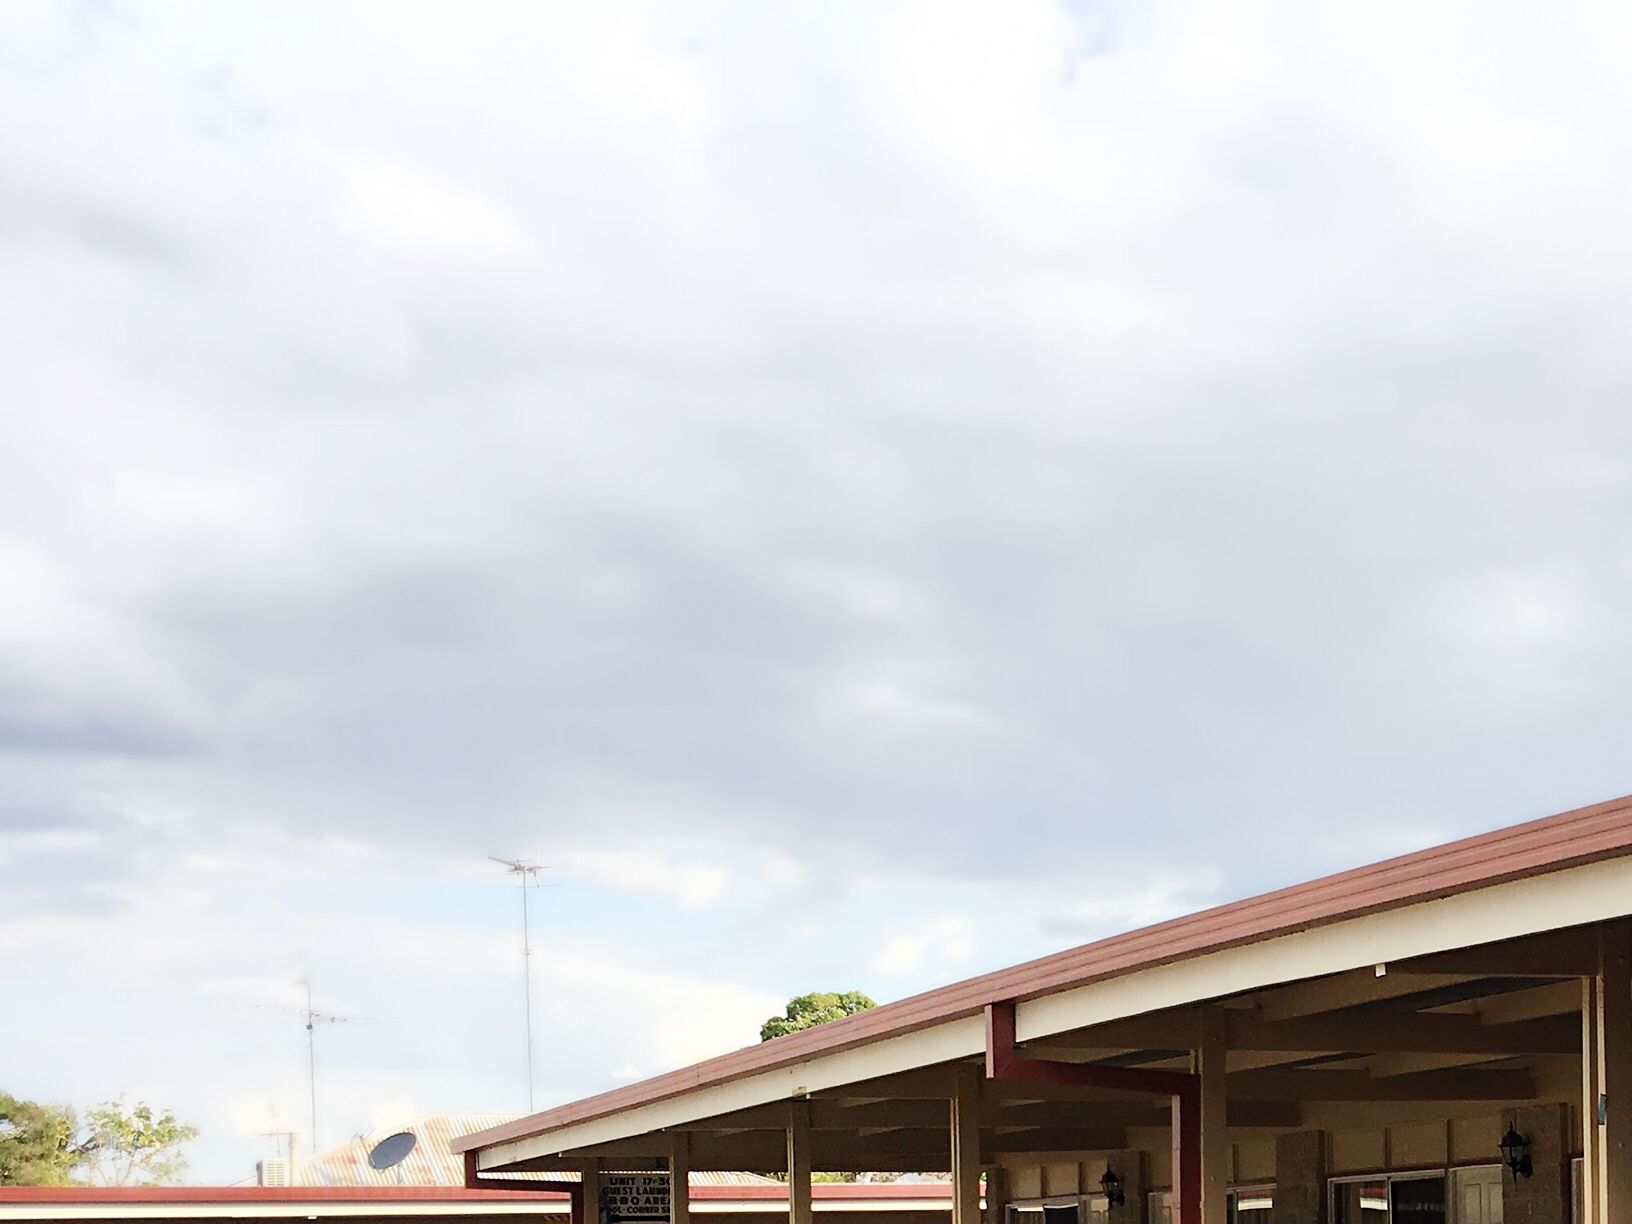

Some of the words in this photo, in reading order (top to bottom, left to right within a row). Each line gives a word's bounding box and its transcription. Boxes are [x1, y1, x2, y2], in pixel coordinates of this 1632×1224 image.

[609, 1177, 635, 1186] UNIT
[602, 1187, 633, 1195] GUEST
[636, 1187, 670, 1195] LAUND
